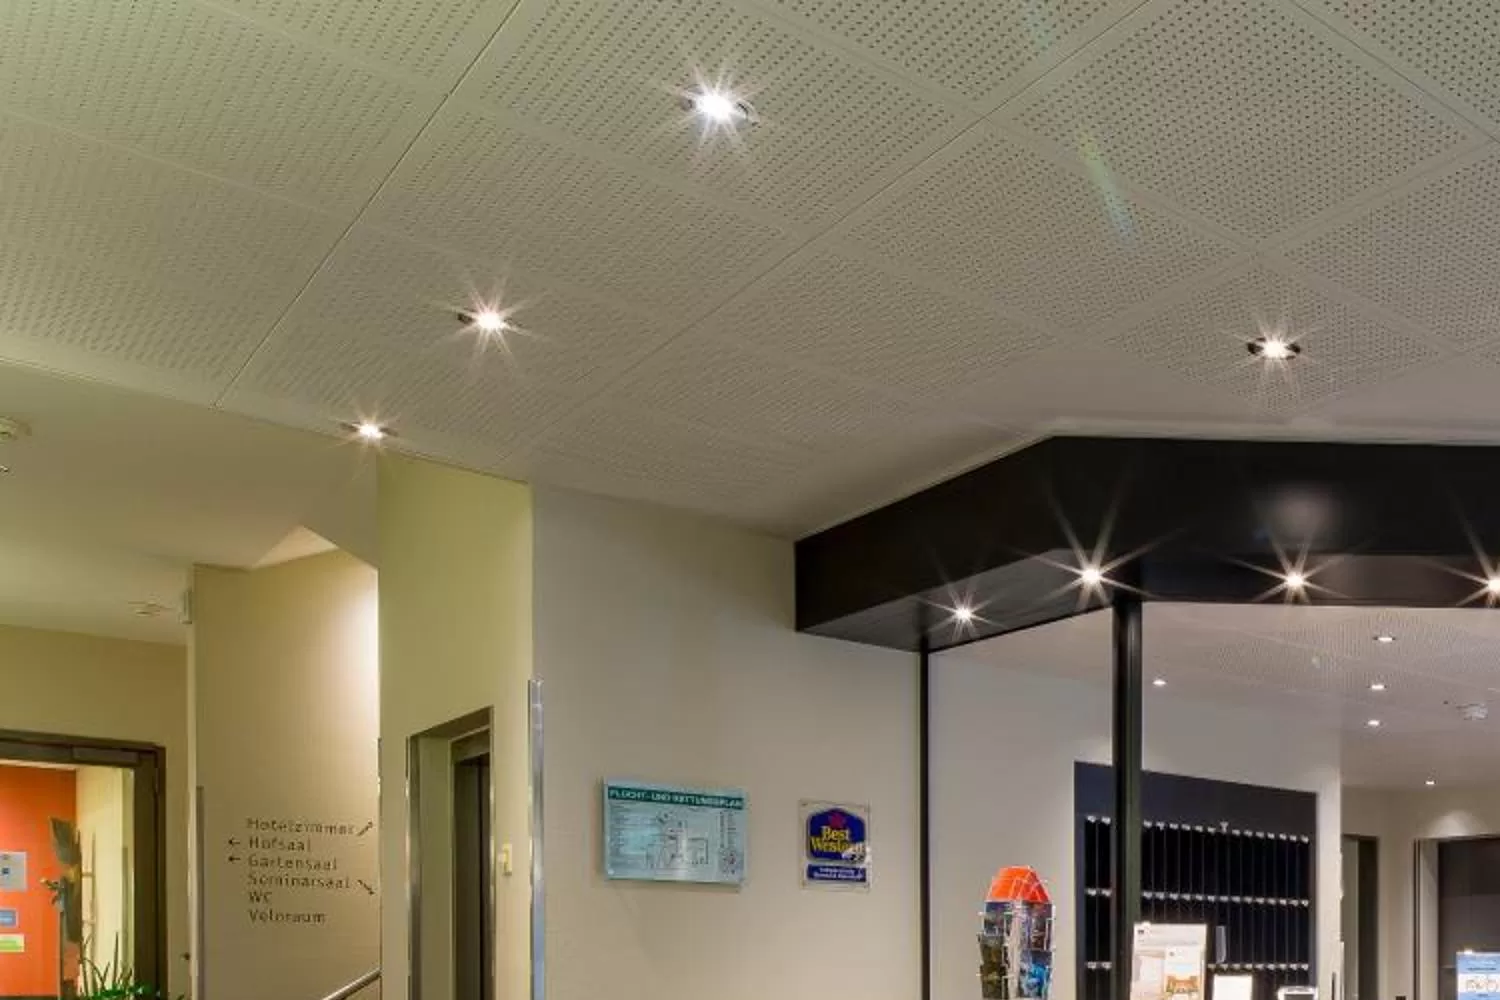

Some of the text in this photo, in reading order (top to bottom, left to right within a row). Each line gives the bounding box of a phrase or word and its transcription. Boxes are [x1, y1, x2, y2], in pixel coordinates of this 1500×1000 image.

[249, 836, 311, 852] Hofsaal
[248, 855, 337, 871] Gartensaal
[248, 873, 350, 890] Seminarsaal
[249, 890, 273, 904] WC
[248, 907, 326, 924] Veloraum
